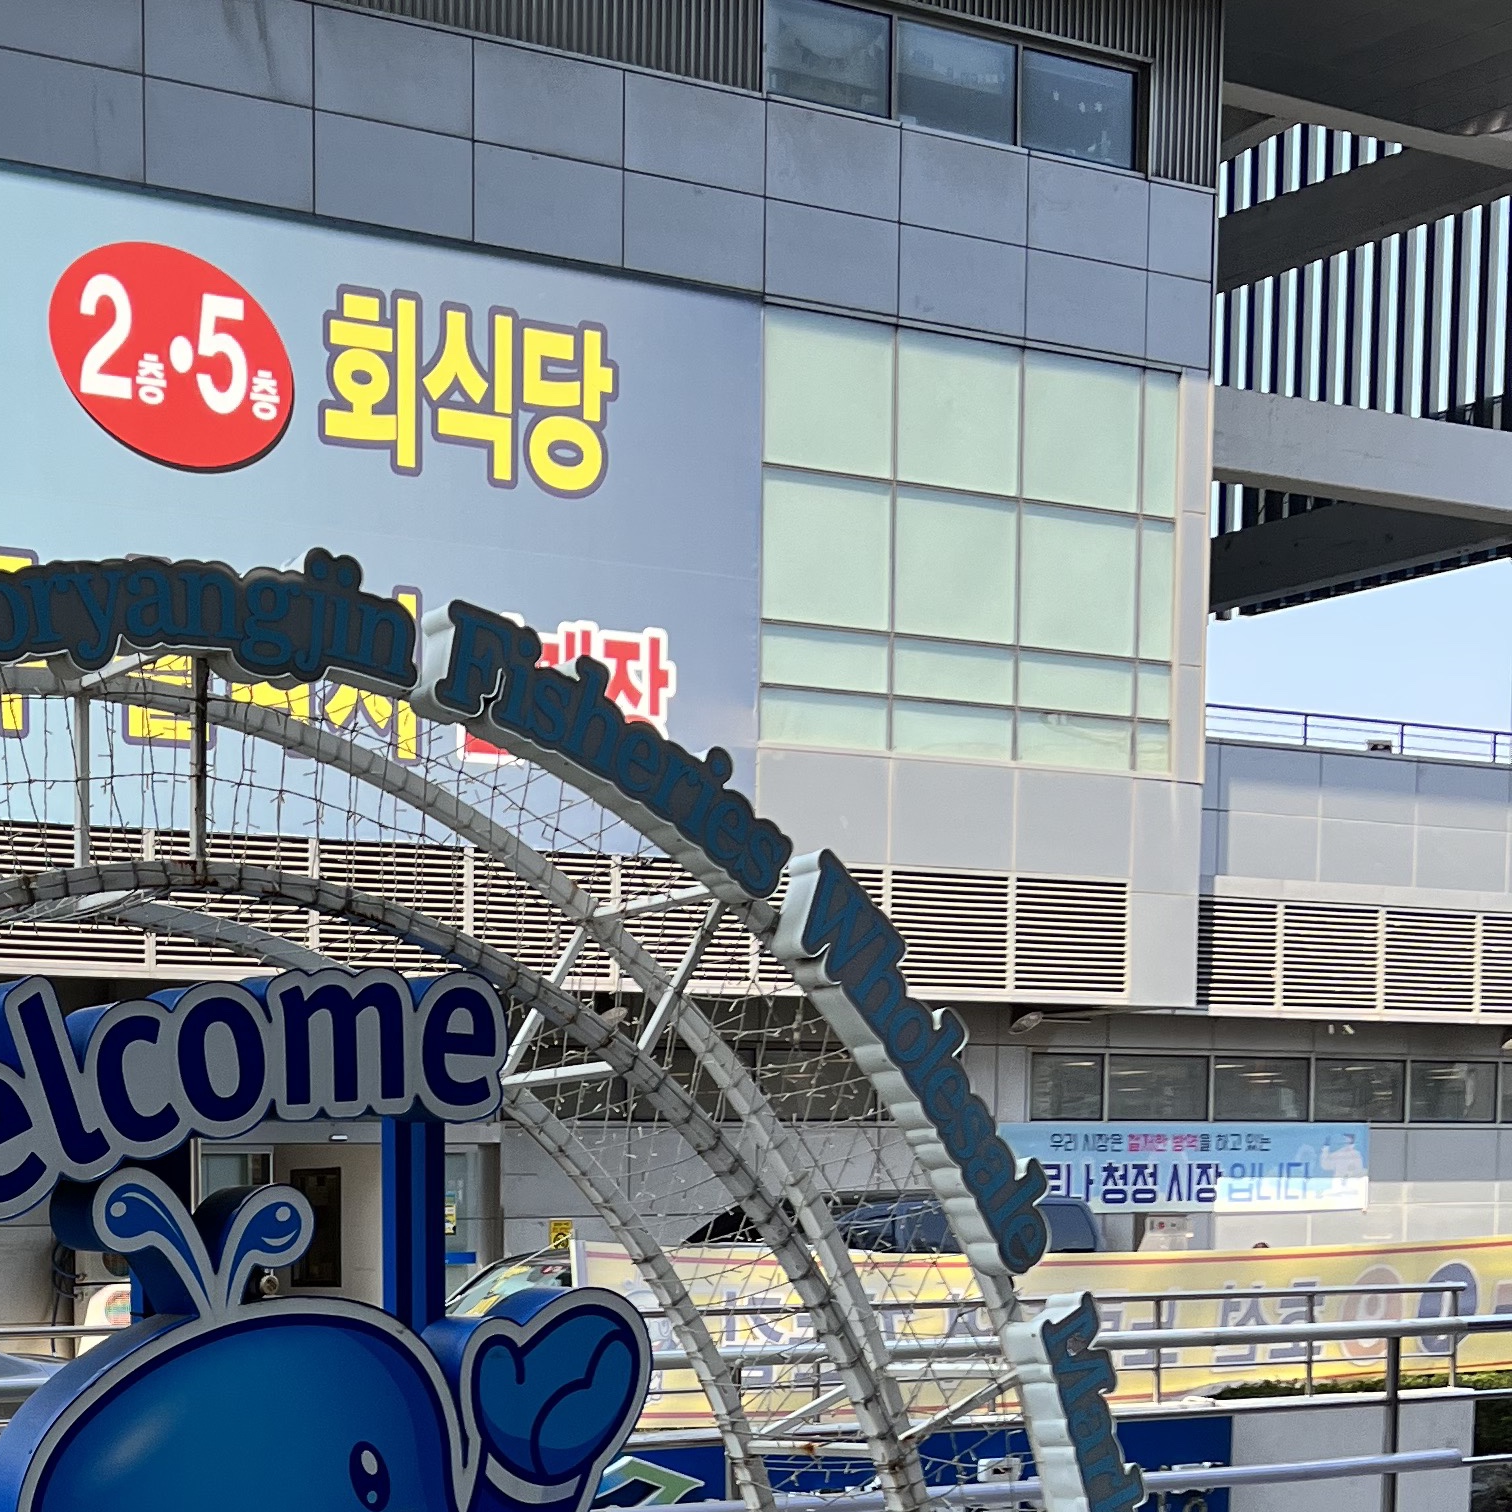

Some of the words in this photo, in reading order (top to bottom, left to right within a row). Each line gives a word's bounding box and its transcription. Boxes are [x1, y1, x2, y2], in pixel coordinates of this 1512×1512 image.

[319, 285, 618, 497] 회식당
[443, 607, 786, 892] Fisheries
[804, 860, 1048, 1270] Wholesale
[1050, 1132, 1077, 1152] 우리
[1101, 1162, 1158, 1204] 청정
[1166, 1162, 1223, 1203] 시장
[1227, 1163, 1311, 1204] 입니다
